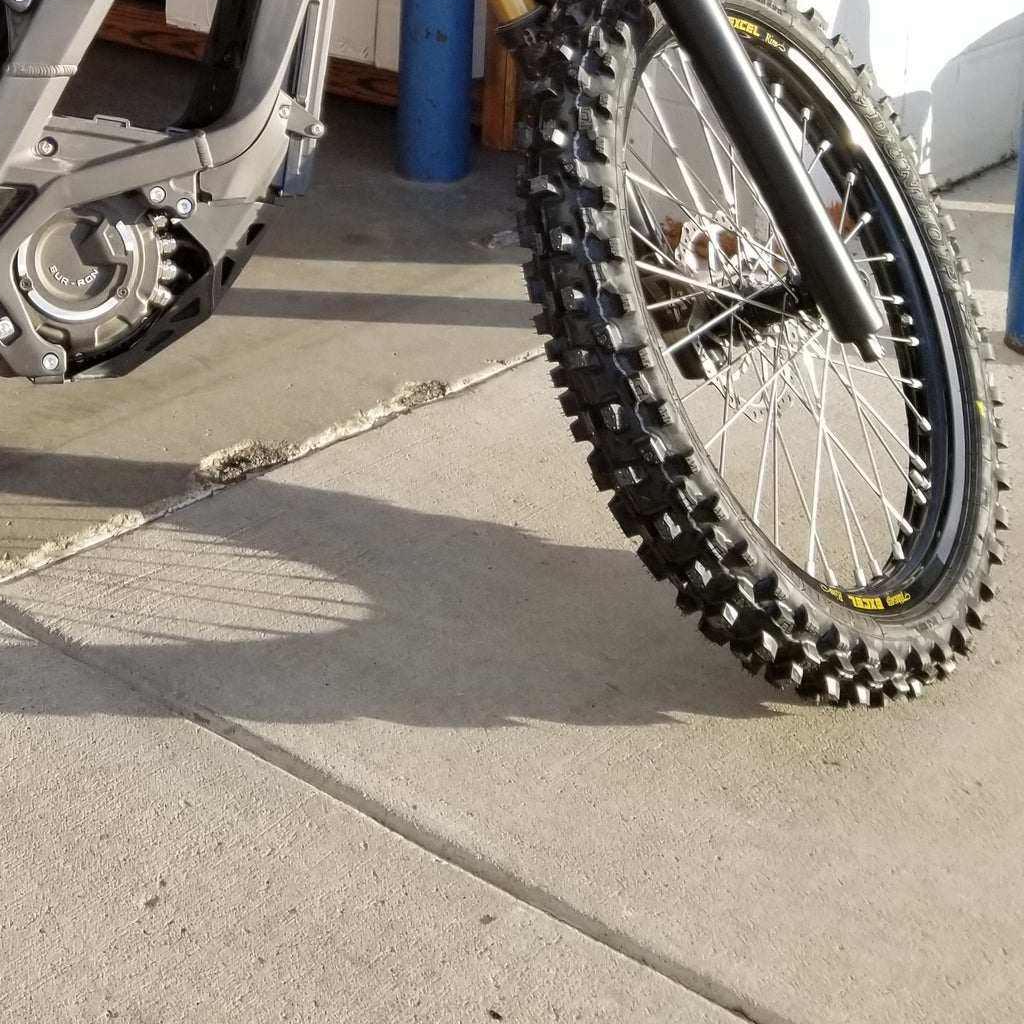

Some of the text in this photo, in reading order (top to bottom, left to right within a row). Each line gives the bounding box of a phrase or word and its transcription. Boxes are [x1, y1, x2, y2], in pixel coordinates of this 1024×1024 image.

[727, 16, 760, 37] EXCEL
[864, 113, 961, 288] DUNLOP
[48, 264, 100, 288] SUR-RON
[847, 594, 885, 610] EXCEL
